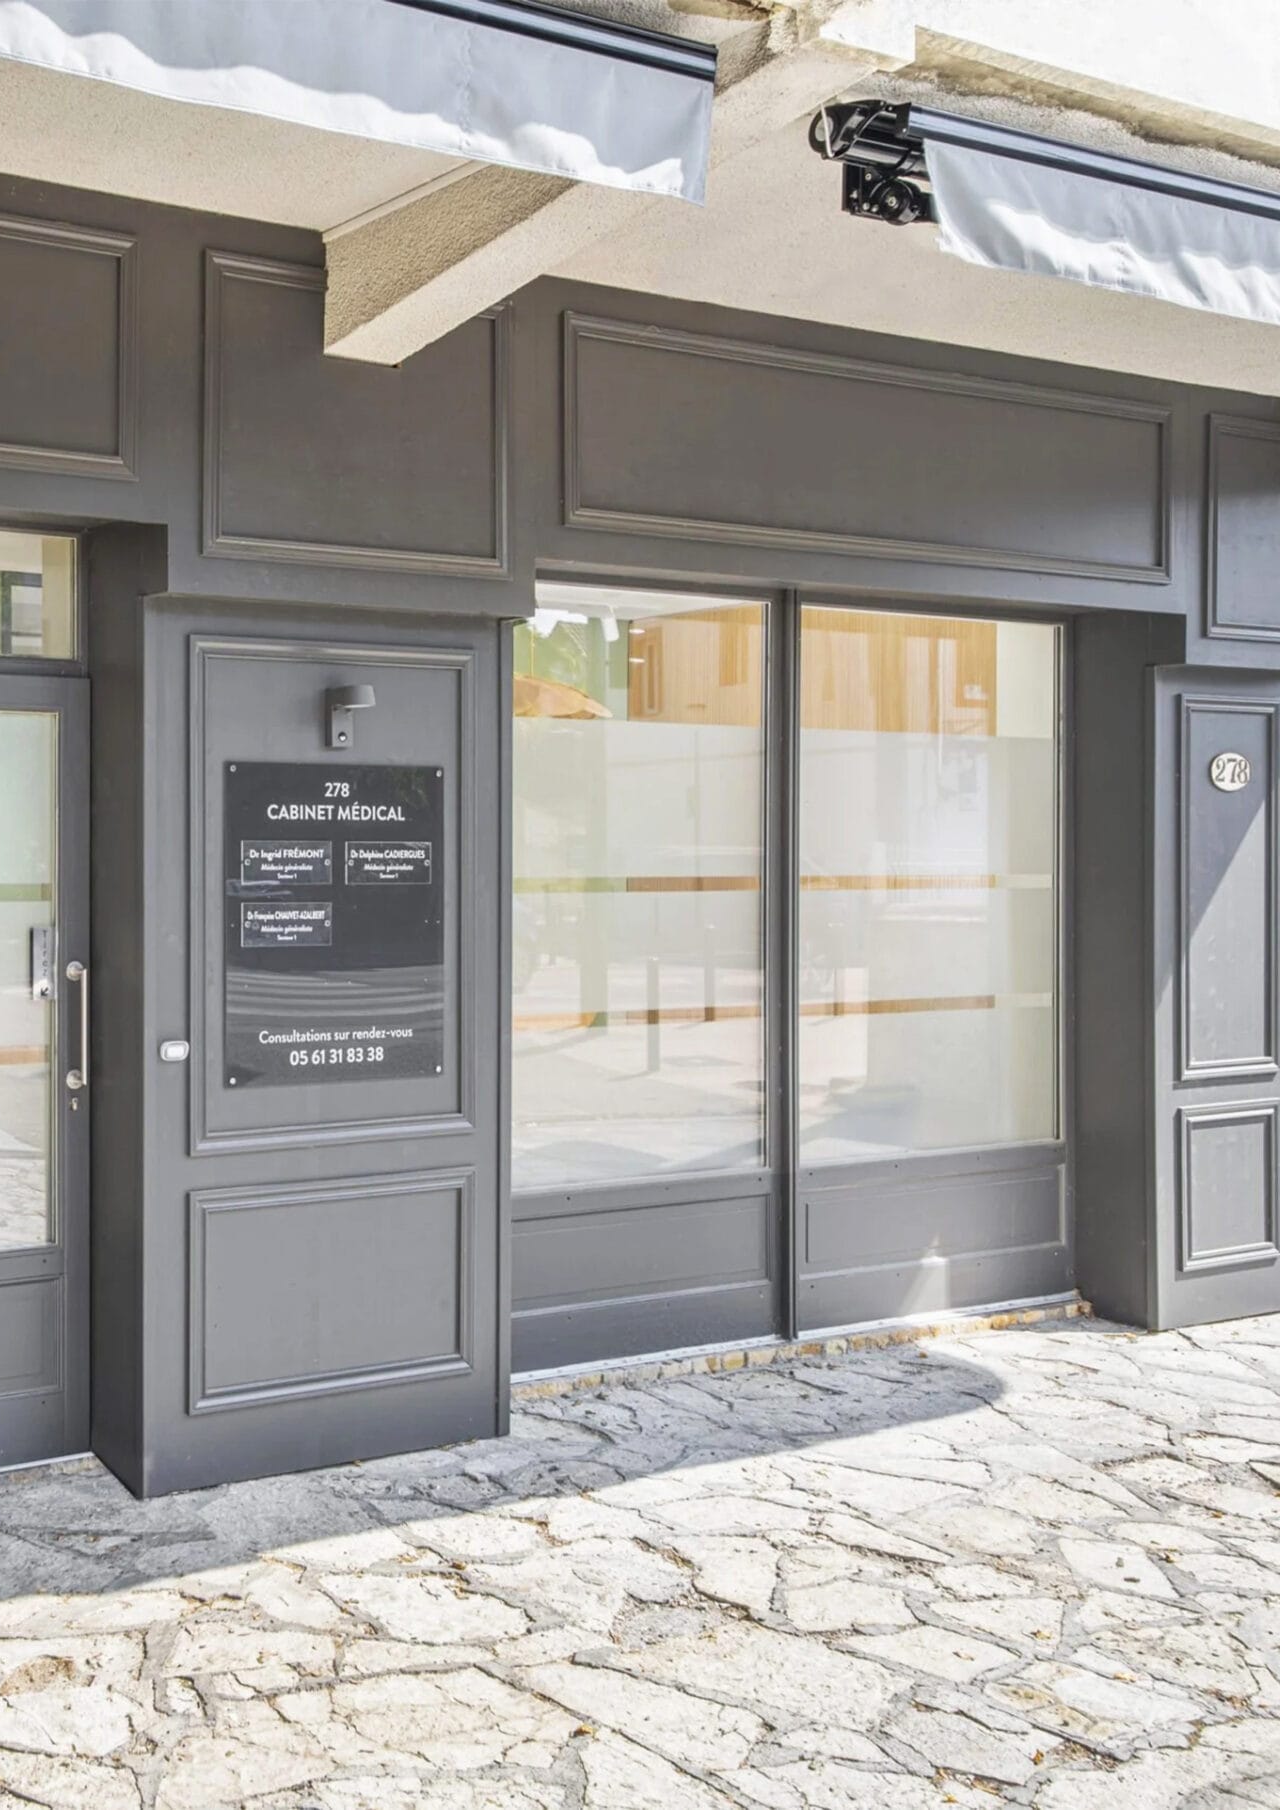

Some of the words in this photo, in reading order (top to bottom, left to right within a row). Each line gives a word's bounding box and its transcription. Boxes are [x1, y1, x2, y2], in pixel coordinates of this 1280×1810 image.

[1214, 757, 1249, 785] 278
[324, 781, 350, 798] 278
[266, 803, 335, 821] CABINET
[337, 801, 406, 822] MÉDICAL
[249, 849, 260, 859] Dr
[260, 849, 282, 862] Ingrid
[283, 847, 324, 859] FRÉMONT
[258, 1028, 332, 1044] Consultations
[333, 1030, 350, 1041] sur
[352, 1026, 413, 1040] rendez-vous
[289, 1050, 309, 1066] 05
[311, 1049, 326, 1065] 61
[329, 1048, 344, 1064] 31
[346, 1047, 364, 1063] 83
[366, 1046, 384, 1062] 38
